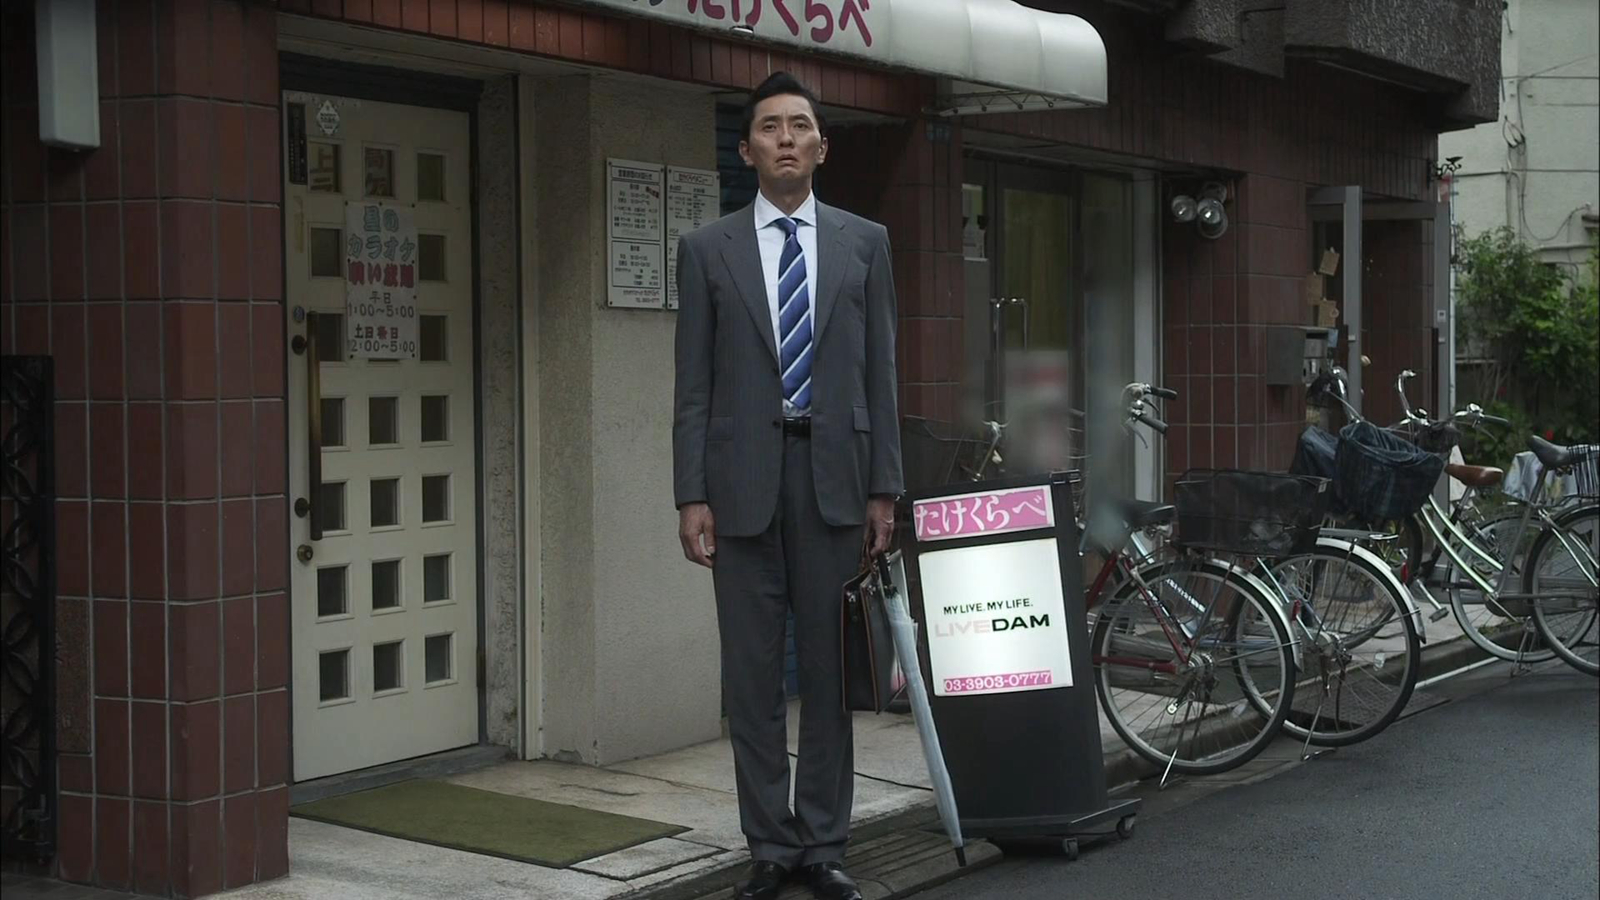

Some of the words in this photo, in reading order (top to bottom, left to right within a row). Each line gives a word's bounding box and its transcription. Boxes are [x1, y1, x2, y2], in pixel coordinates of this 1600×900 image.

[348, 233, 415, 261] カラオケ
[369, 291, 391, 304] 平日
[915, 494, 1046, 536] たけくらべ
[943, 605, 957, 614] MY
[960, 603, 985, 613] LIVE.
[987, 601, 1003, 611] MY
[1006, 598, 1033, 608] LIFE.
[945, 671, 1051, 692] 03-3903-0777
